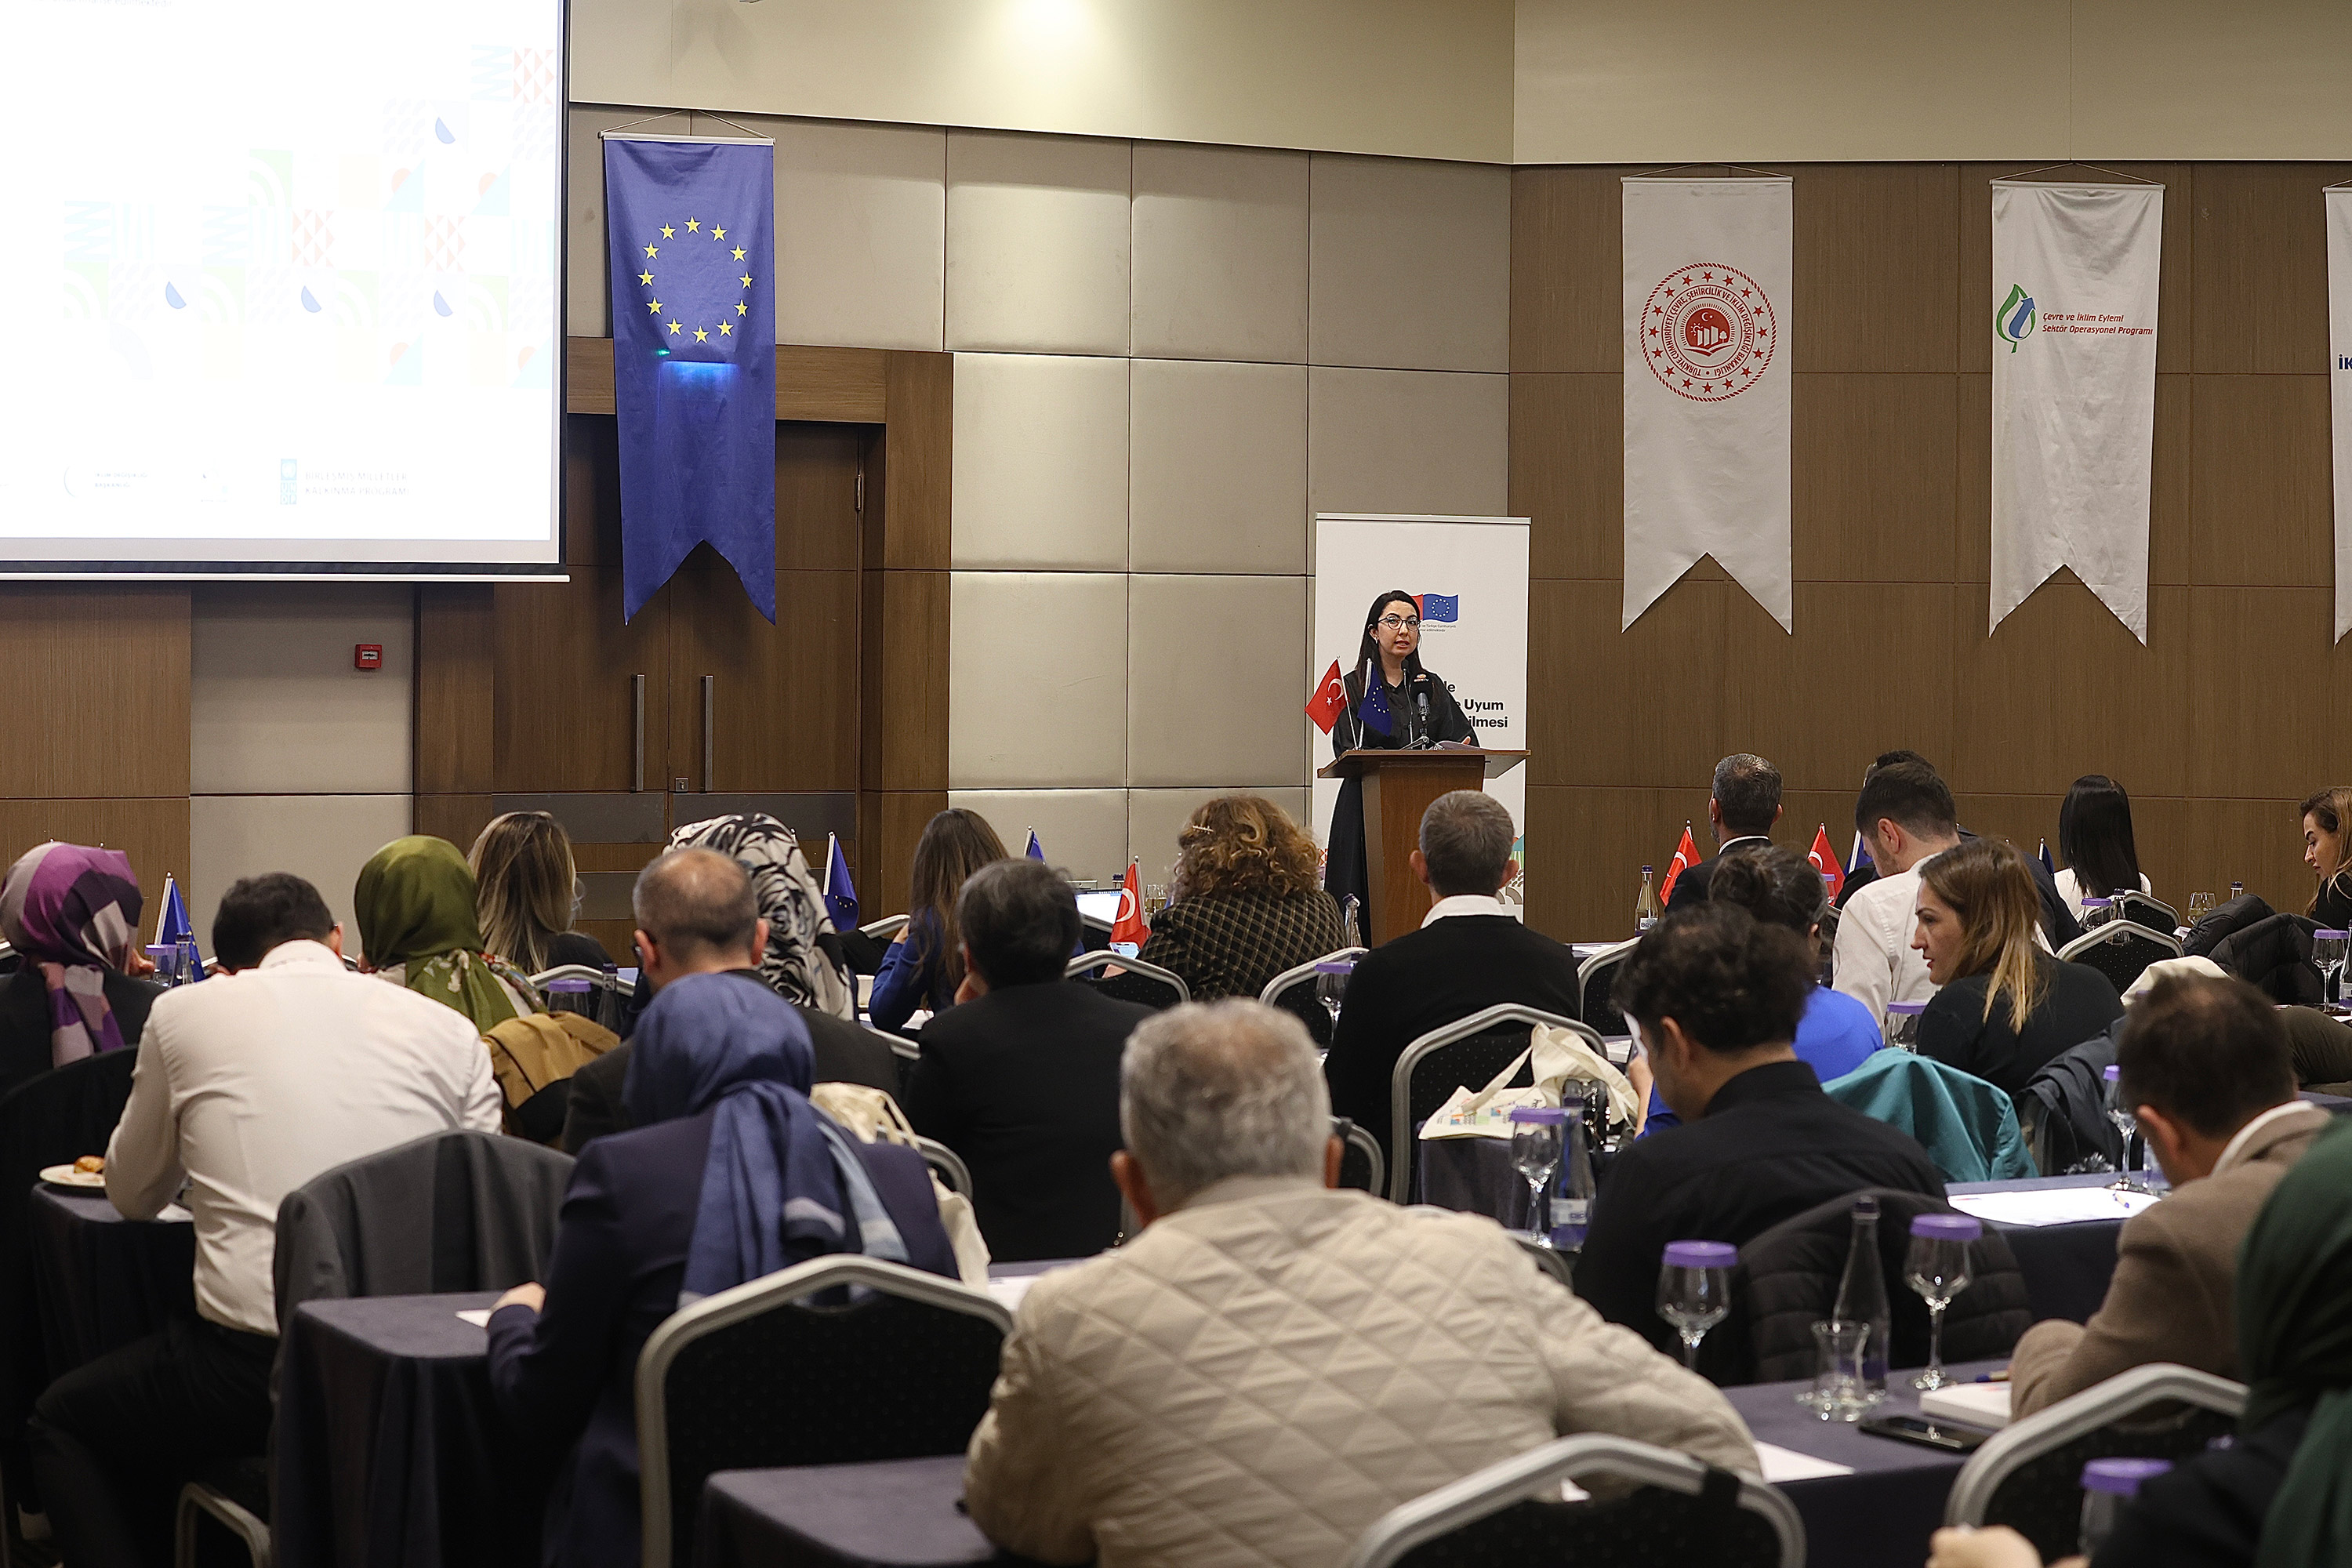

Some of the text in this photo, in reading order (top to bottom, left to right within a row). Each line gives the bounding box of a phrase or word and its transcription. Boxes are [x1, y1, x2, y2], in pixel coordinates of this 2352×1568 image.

[1686, 286, 1722, 301] ŞEHİRCİLİK
[1722, 292, 1730, 300] VE
[1729, 296, 1745, 317] İKLİM
[2042, 312, 2064, 321] Çevre
[2076, 312, 2096, 321] İklim
[1664, 315, 1679, 358] CUMHURİYETİ
[1740, 313, 1753, 354] DEĞİŞİKLİĞİ
[2069, 325, 2117, 335] Operasyonel
[2118, 327, 2154, 336] Programı
[1676, 358, 1701, 377] TÜRKİYE
[1714, 352, 1745, 377] BAKANLIĞI
[1465, 699, 1504, 713] Uyum
